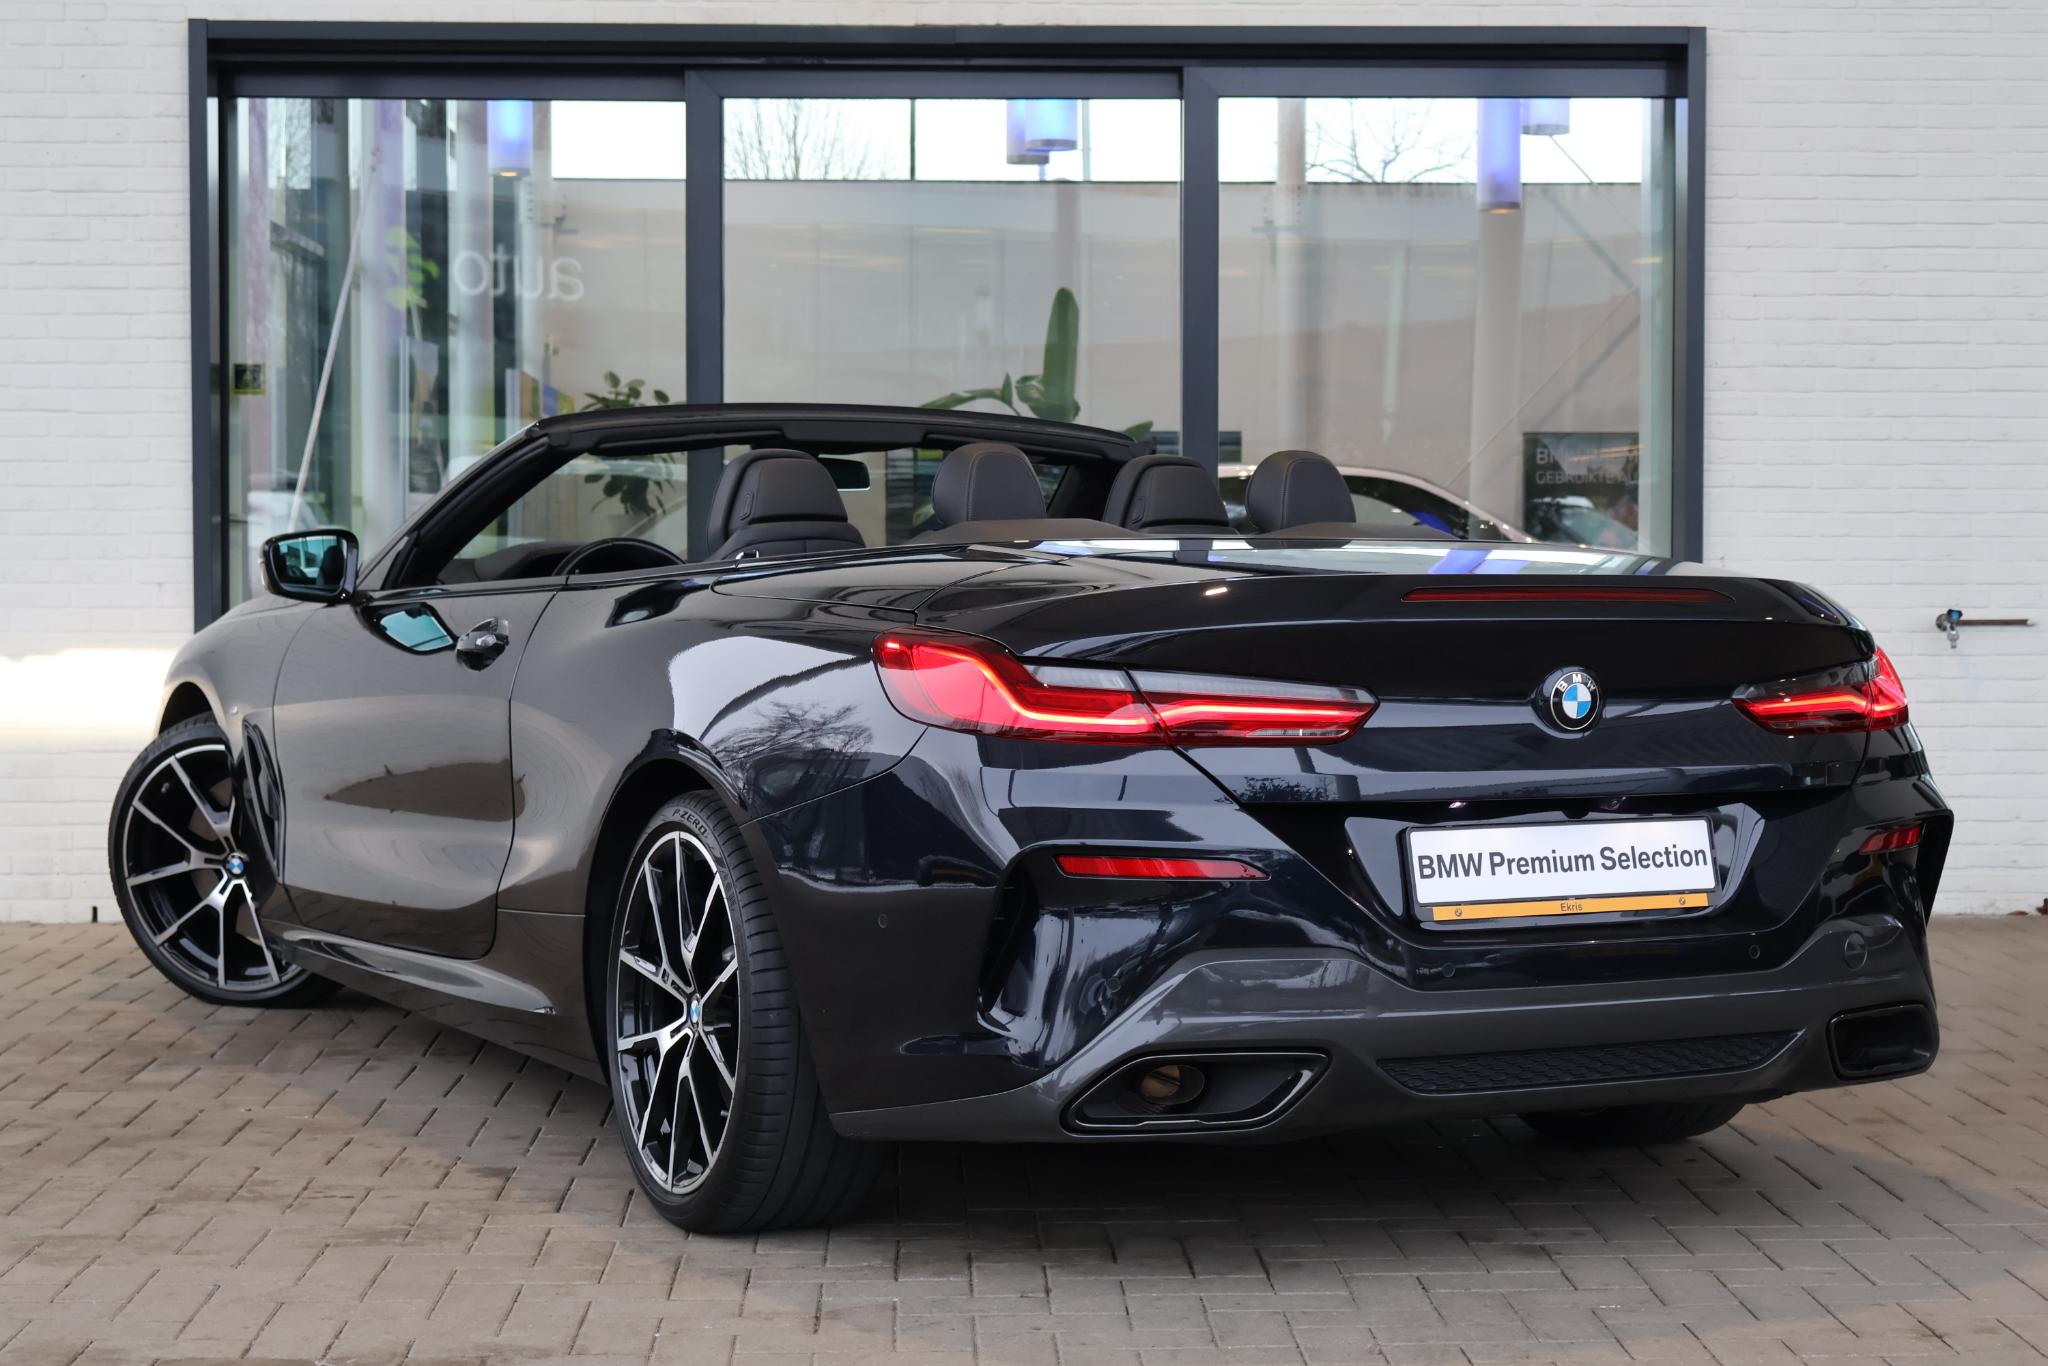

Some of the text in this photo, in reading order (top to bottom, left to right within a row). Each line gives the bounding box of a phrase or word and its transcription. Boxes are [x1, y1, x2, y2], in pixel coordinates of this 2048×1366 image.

[1557, 673, 1596, 692] BMW
[1417, 844, 1708, 879] BMW Premium Selection
[1560, 902, 1583, 912] Ekris
